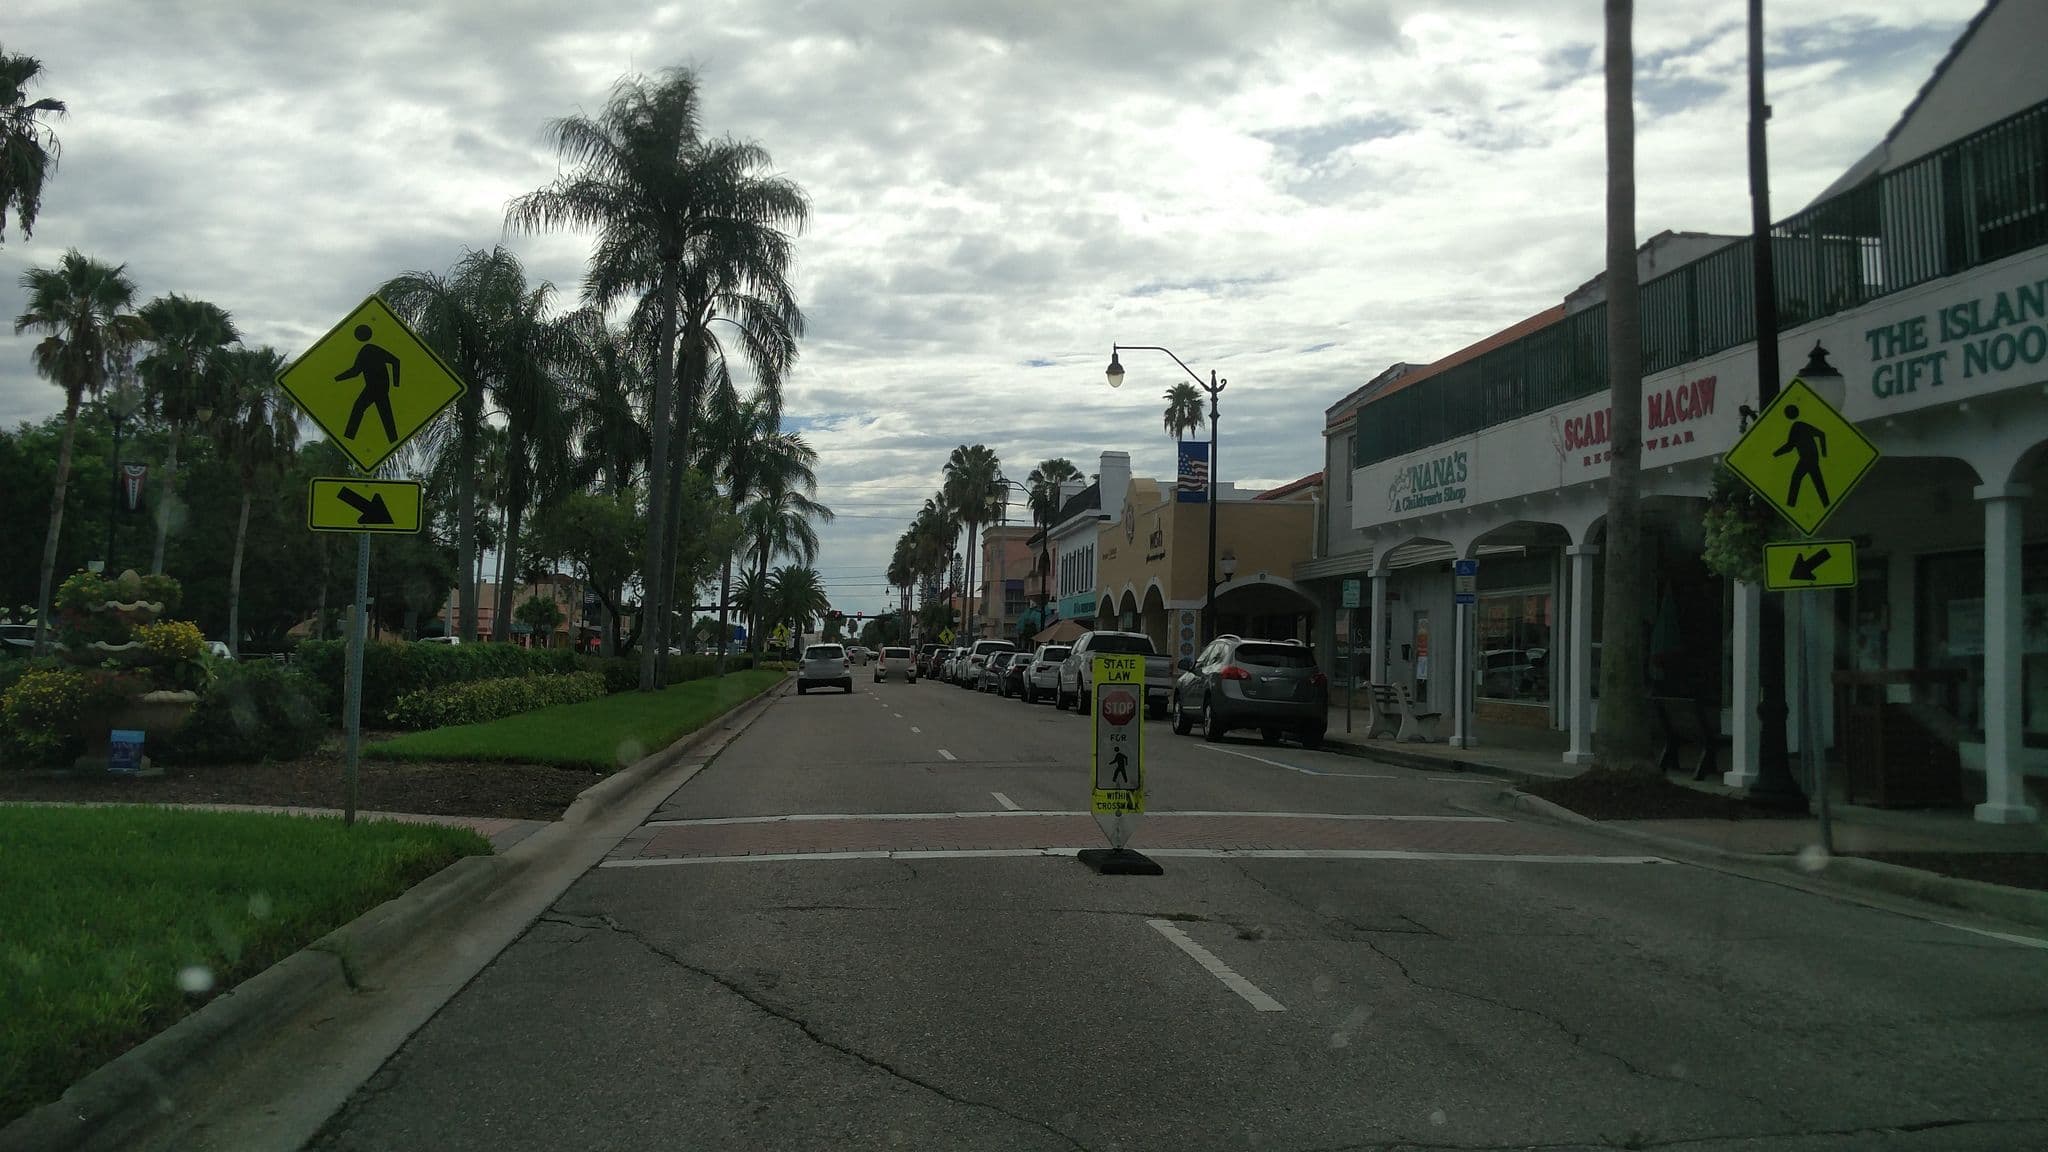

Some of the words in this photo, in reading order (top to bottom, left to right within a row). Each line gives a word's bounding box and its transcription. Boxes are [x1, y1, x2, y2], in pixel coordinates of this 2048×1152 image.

[1865, 315, 1928, 361] THE
[1938, 278, 2048, 343] ISLAN
[1872, 351, 1947, 399] GIFT
[1962, 325, 2048, 378] NOO
[1647, 375, 1717, 430] MACAW
[1410, 450, 1467, 493] NANA'S
[1443, 486, 1467, 503] Shop
[1104, 658, 1136, 669] STATE
[1108, 671, 1131, 681] LAW
[1104, 702, 1134, 715] STOP
[1110, 734, 1127, 742] FOR
